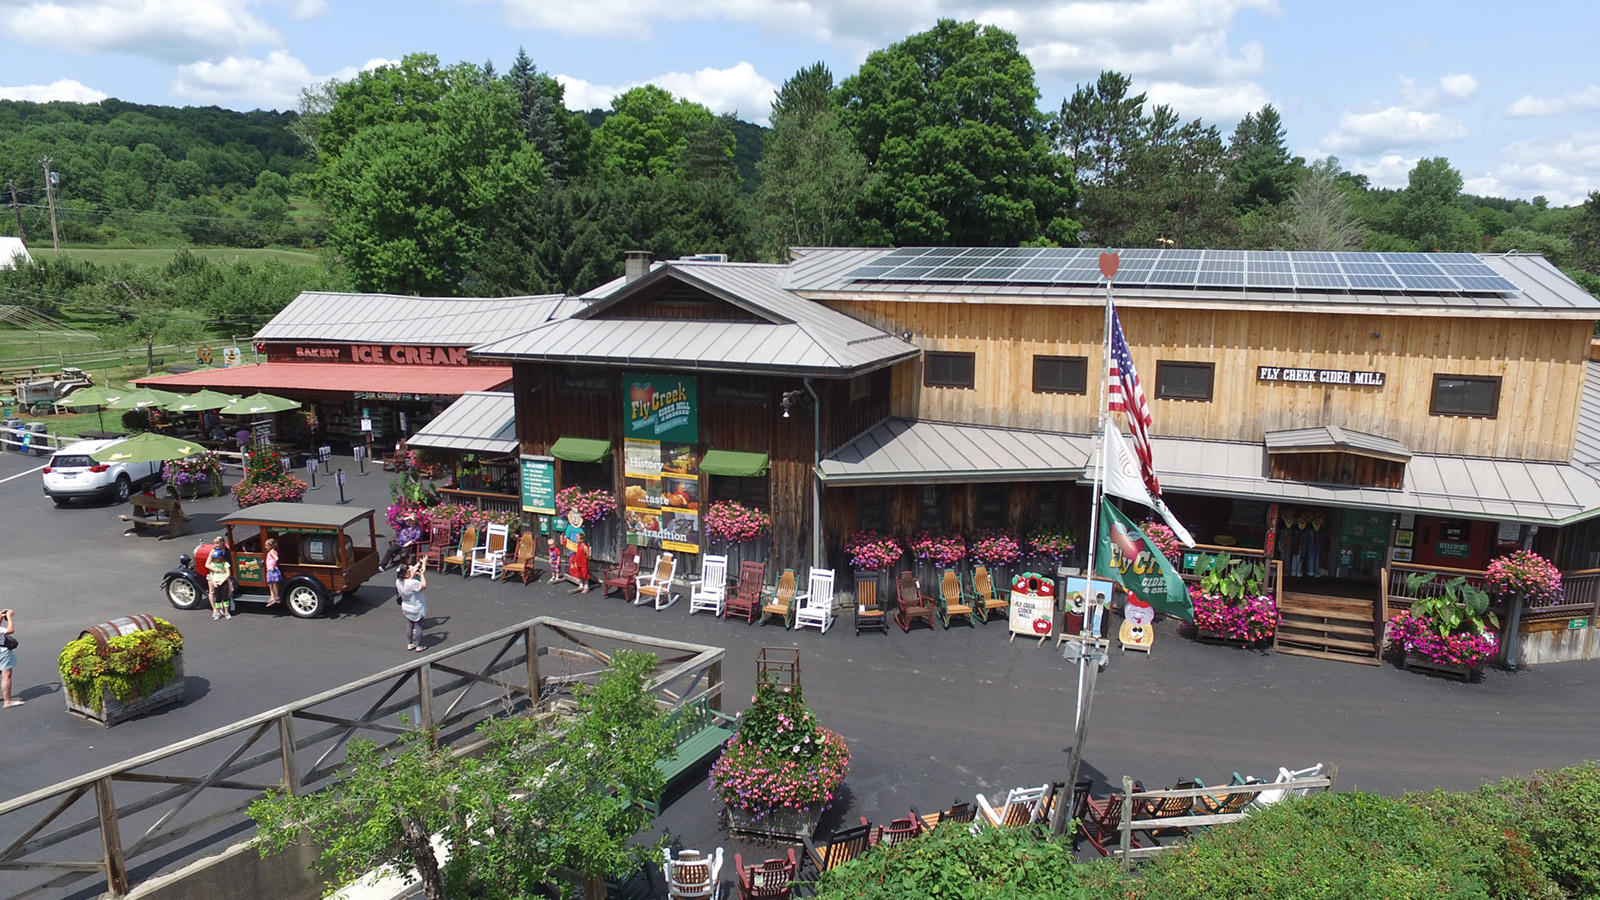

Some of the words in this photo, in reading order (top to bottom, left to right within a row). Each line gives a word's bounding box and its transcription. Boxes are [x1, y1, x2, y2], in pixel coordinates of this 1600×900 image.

[296, 347, 340, 358] BAKERY
[351, 345, 384, 363] ICE
[390, 346, 468, 365] CREAM
[1260, 367, 1280, 380] FLY
[1283, 369, 1317, 382] CREEK
[1319, 371, 1351, 384] CIDER
[1354, 372, 1383, 385] MILL
[632, 400, 650, 420] Fly
[652, 382, 687, 411] Creek
[658, 404, 676, 417] CIDER
[676, 401, 690, 410] MILL
[630, 457, 664, 472] History
[1110, 543, 1133, 574] Fly
[1141, 577, 1167, 587] CIDE
